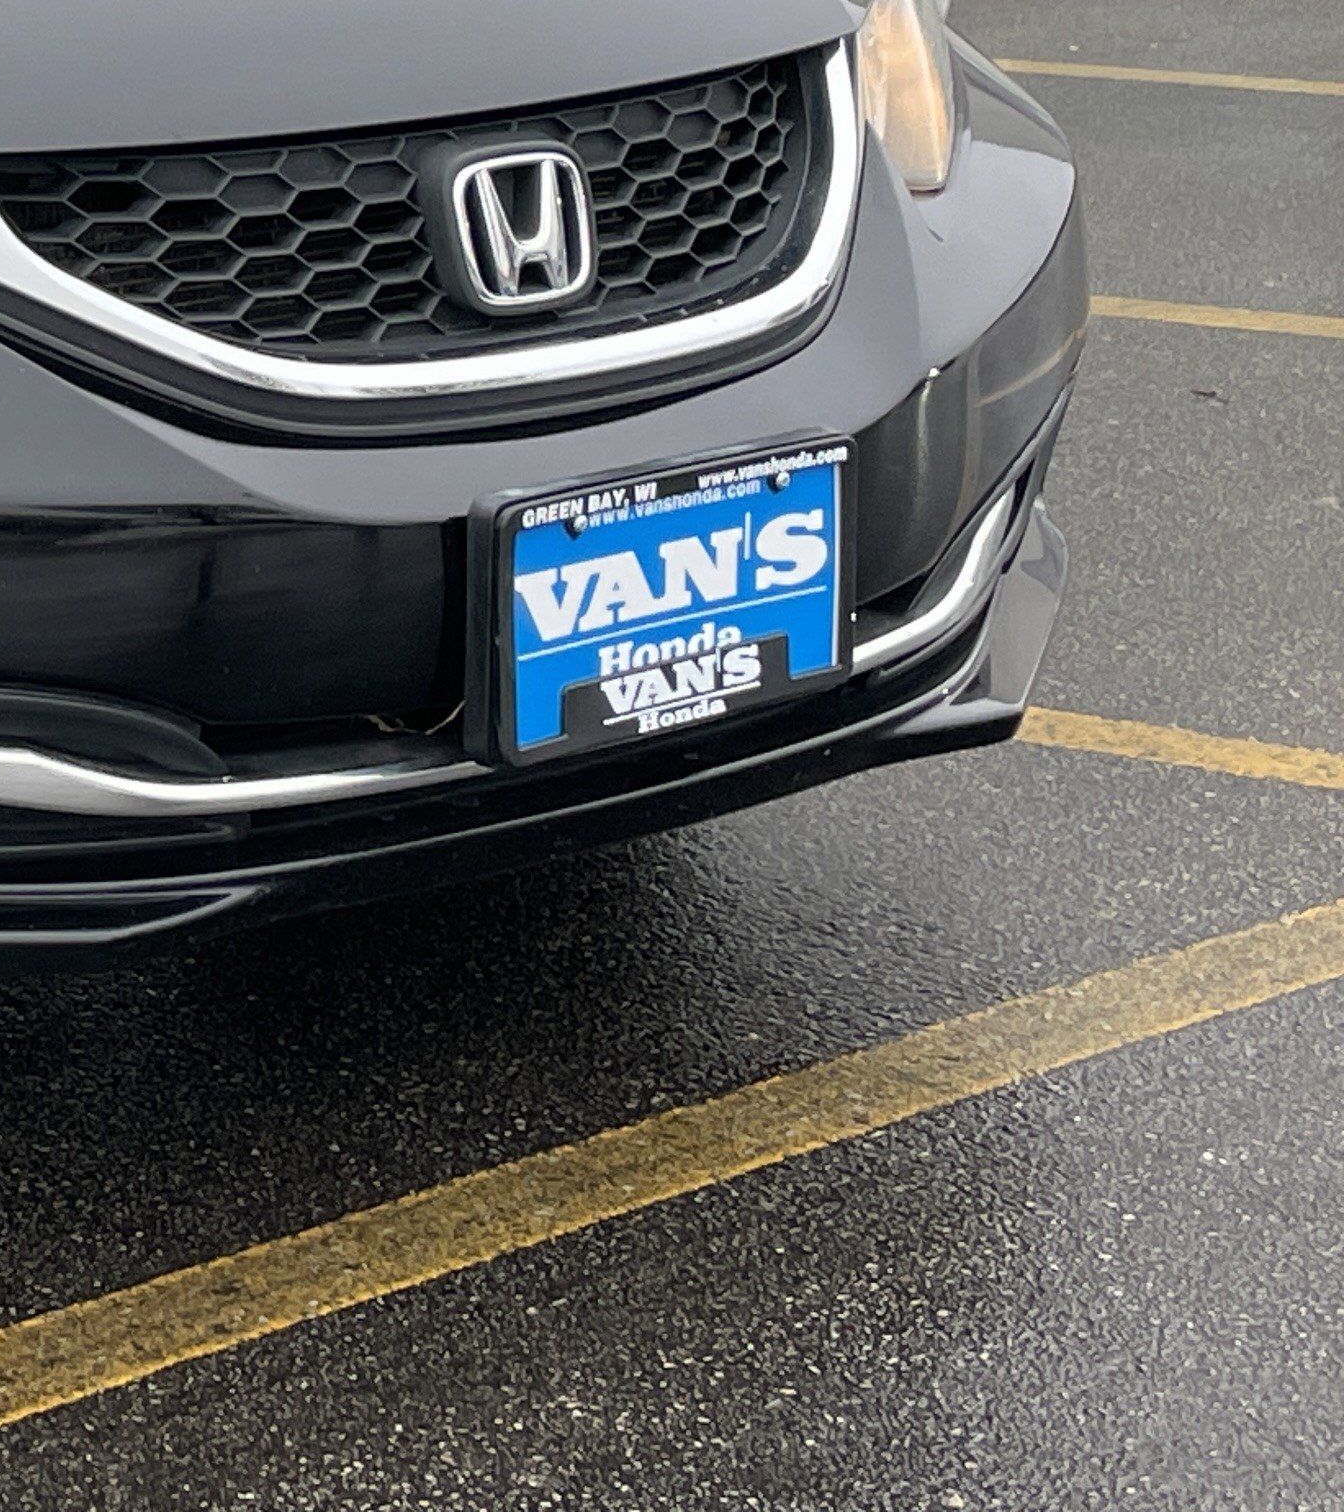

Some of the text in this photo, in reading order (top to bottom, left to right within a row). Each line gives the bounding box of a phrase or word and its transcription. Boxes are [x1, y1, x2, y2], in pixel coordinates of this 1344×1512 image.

[698, 445, 849, 489] www.vanshonda.com
[521, 481, 658, 529] GREEN BAY, WI
[589, 479, 761, 529] www.vanshonda.com
[514, 508, 828, 642] VAN'S
[598, 621, 742, 677] Honda
[600, 644, 762, 715] VAN'S
[637, 698, 727, 734] Honda
